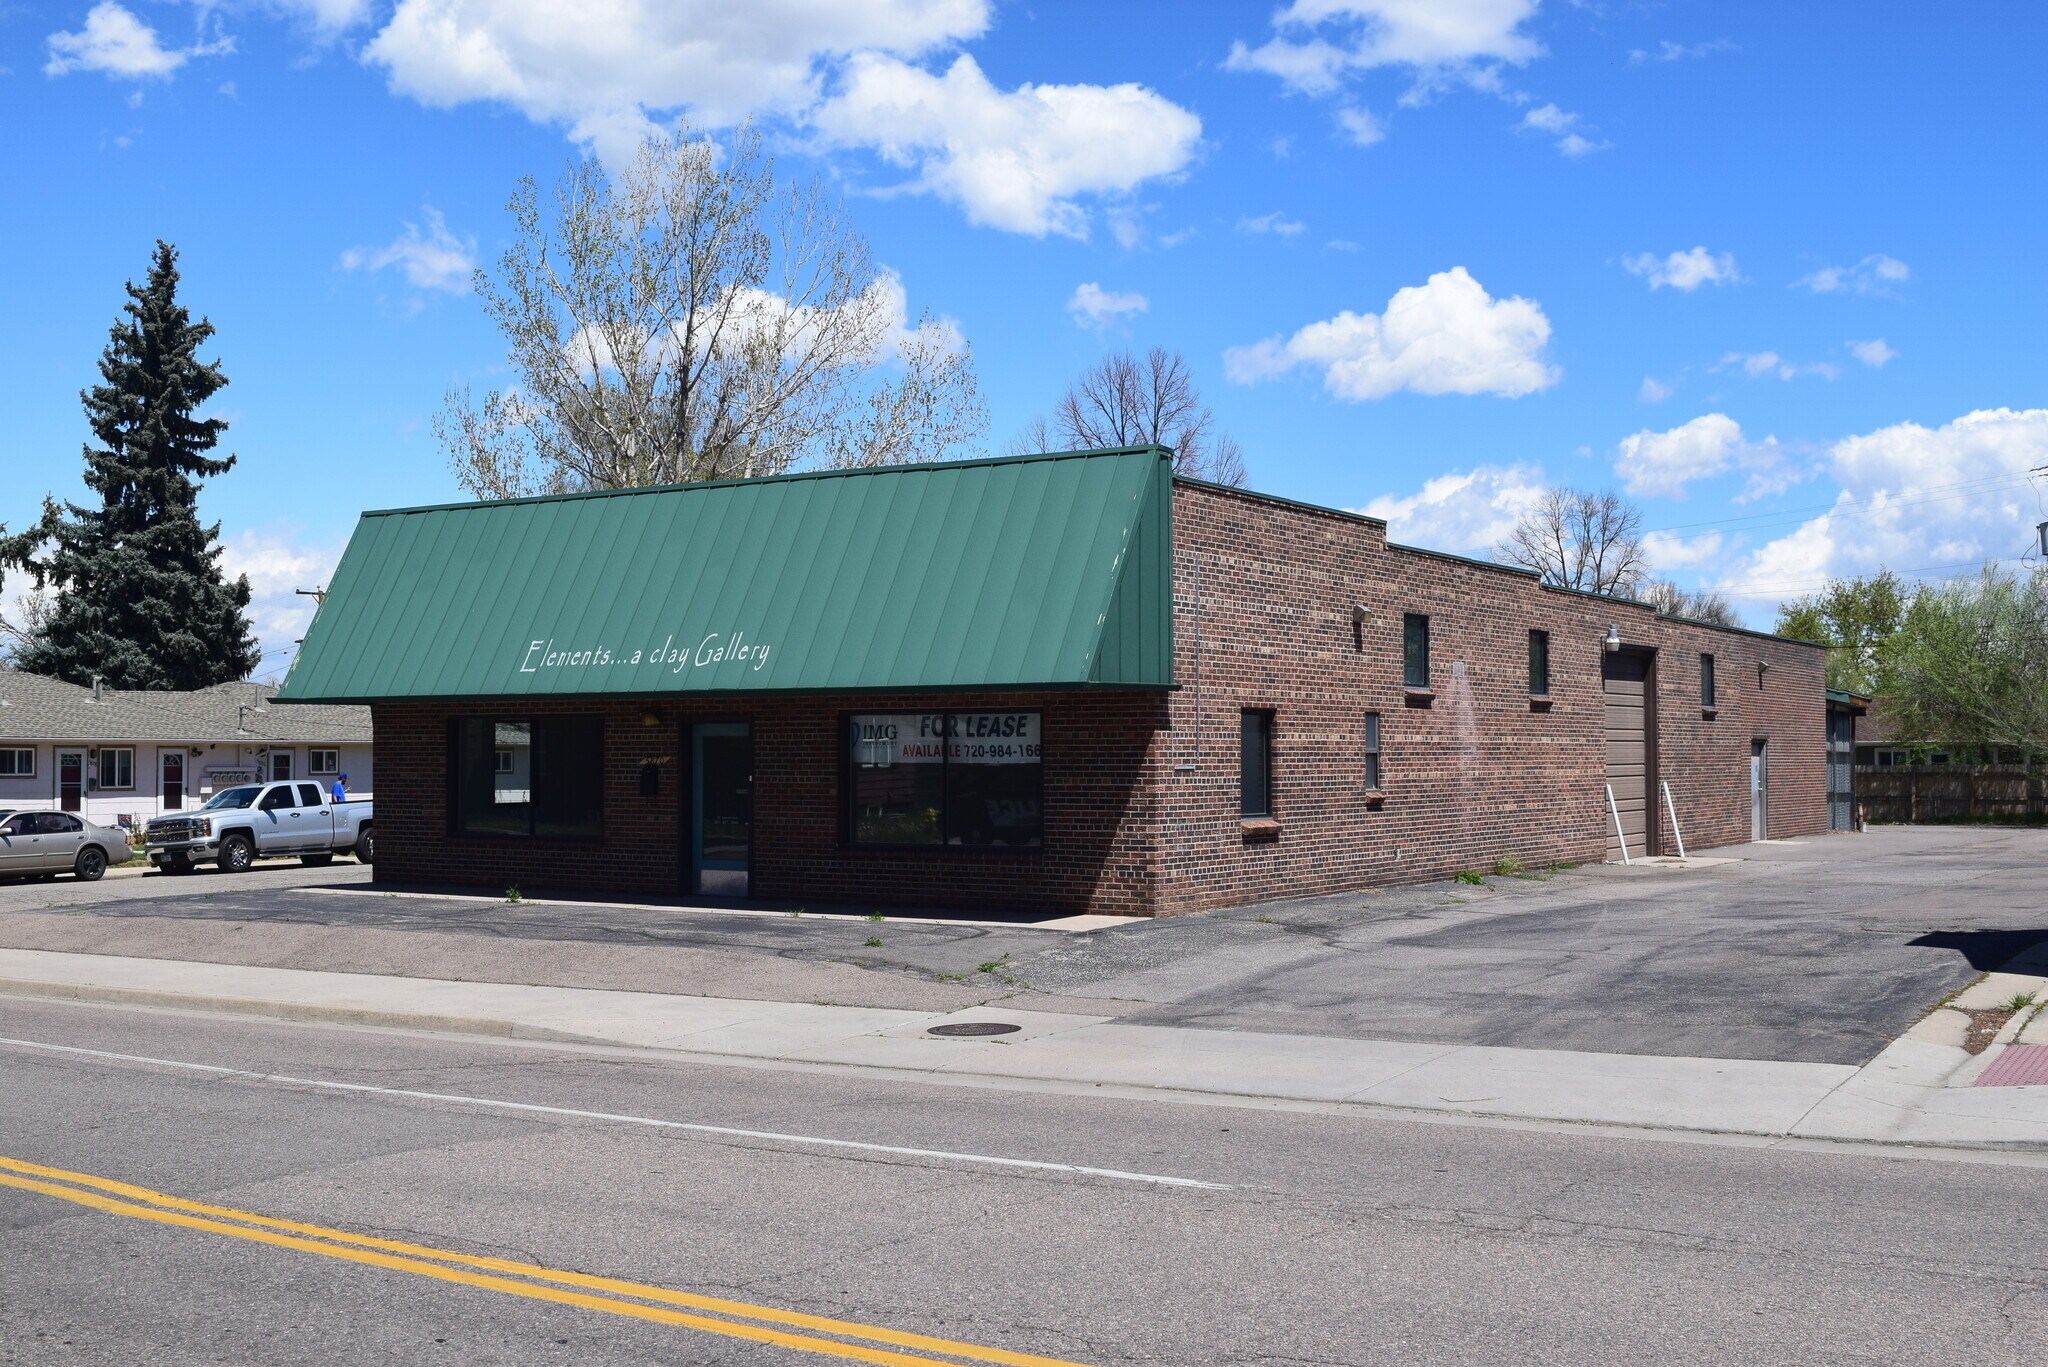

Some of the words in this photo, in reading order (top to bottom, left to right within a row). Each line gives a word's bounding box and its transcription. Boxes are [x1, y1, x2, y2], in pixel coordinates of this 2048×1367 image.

[650, 634, 690, 673] clay
[695, 632, 770, 671] Gallery
[863, 725, 898, 740] IMG
[920, 715, 959, 738] FOR
[966, 715, 1028, 738] LEASE
[902, 745, 960, 757] AVAILALE
